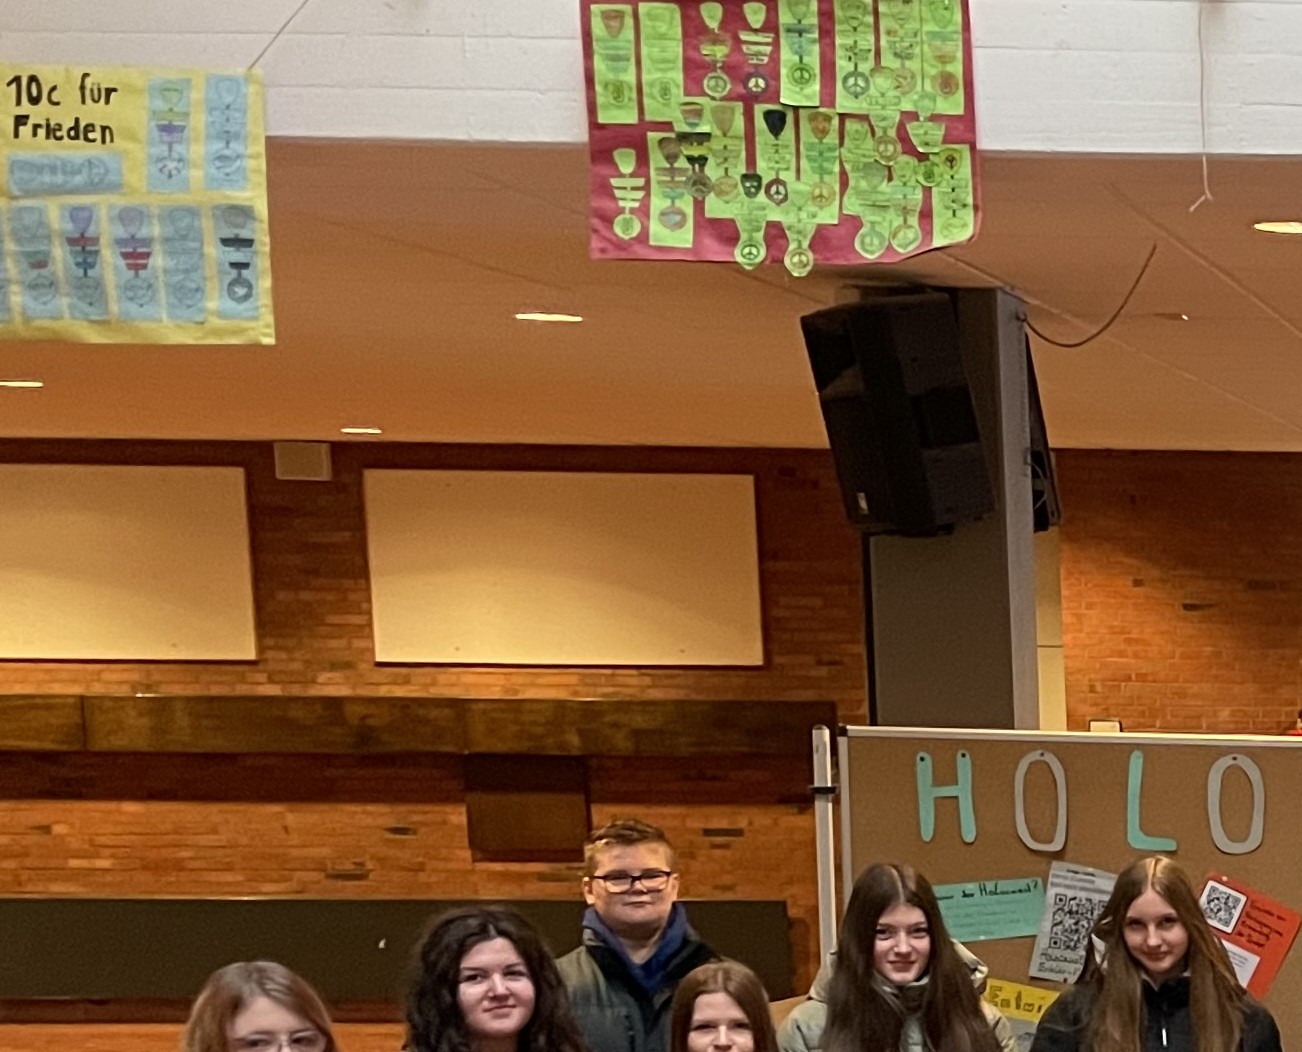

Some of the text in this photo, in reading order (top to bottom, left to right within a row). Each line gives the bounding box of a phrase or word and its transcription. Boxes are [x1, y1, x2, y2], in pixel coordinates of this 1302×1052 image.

[78, 73, 118, 106] für
[12, 114, 115, 145] Frieden
[915, 749, 1265, 854] HOLO
